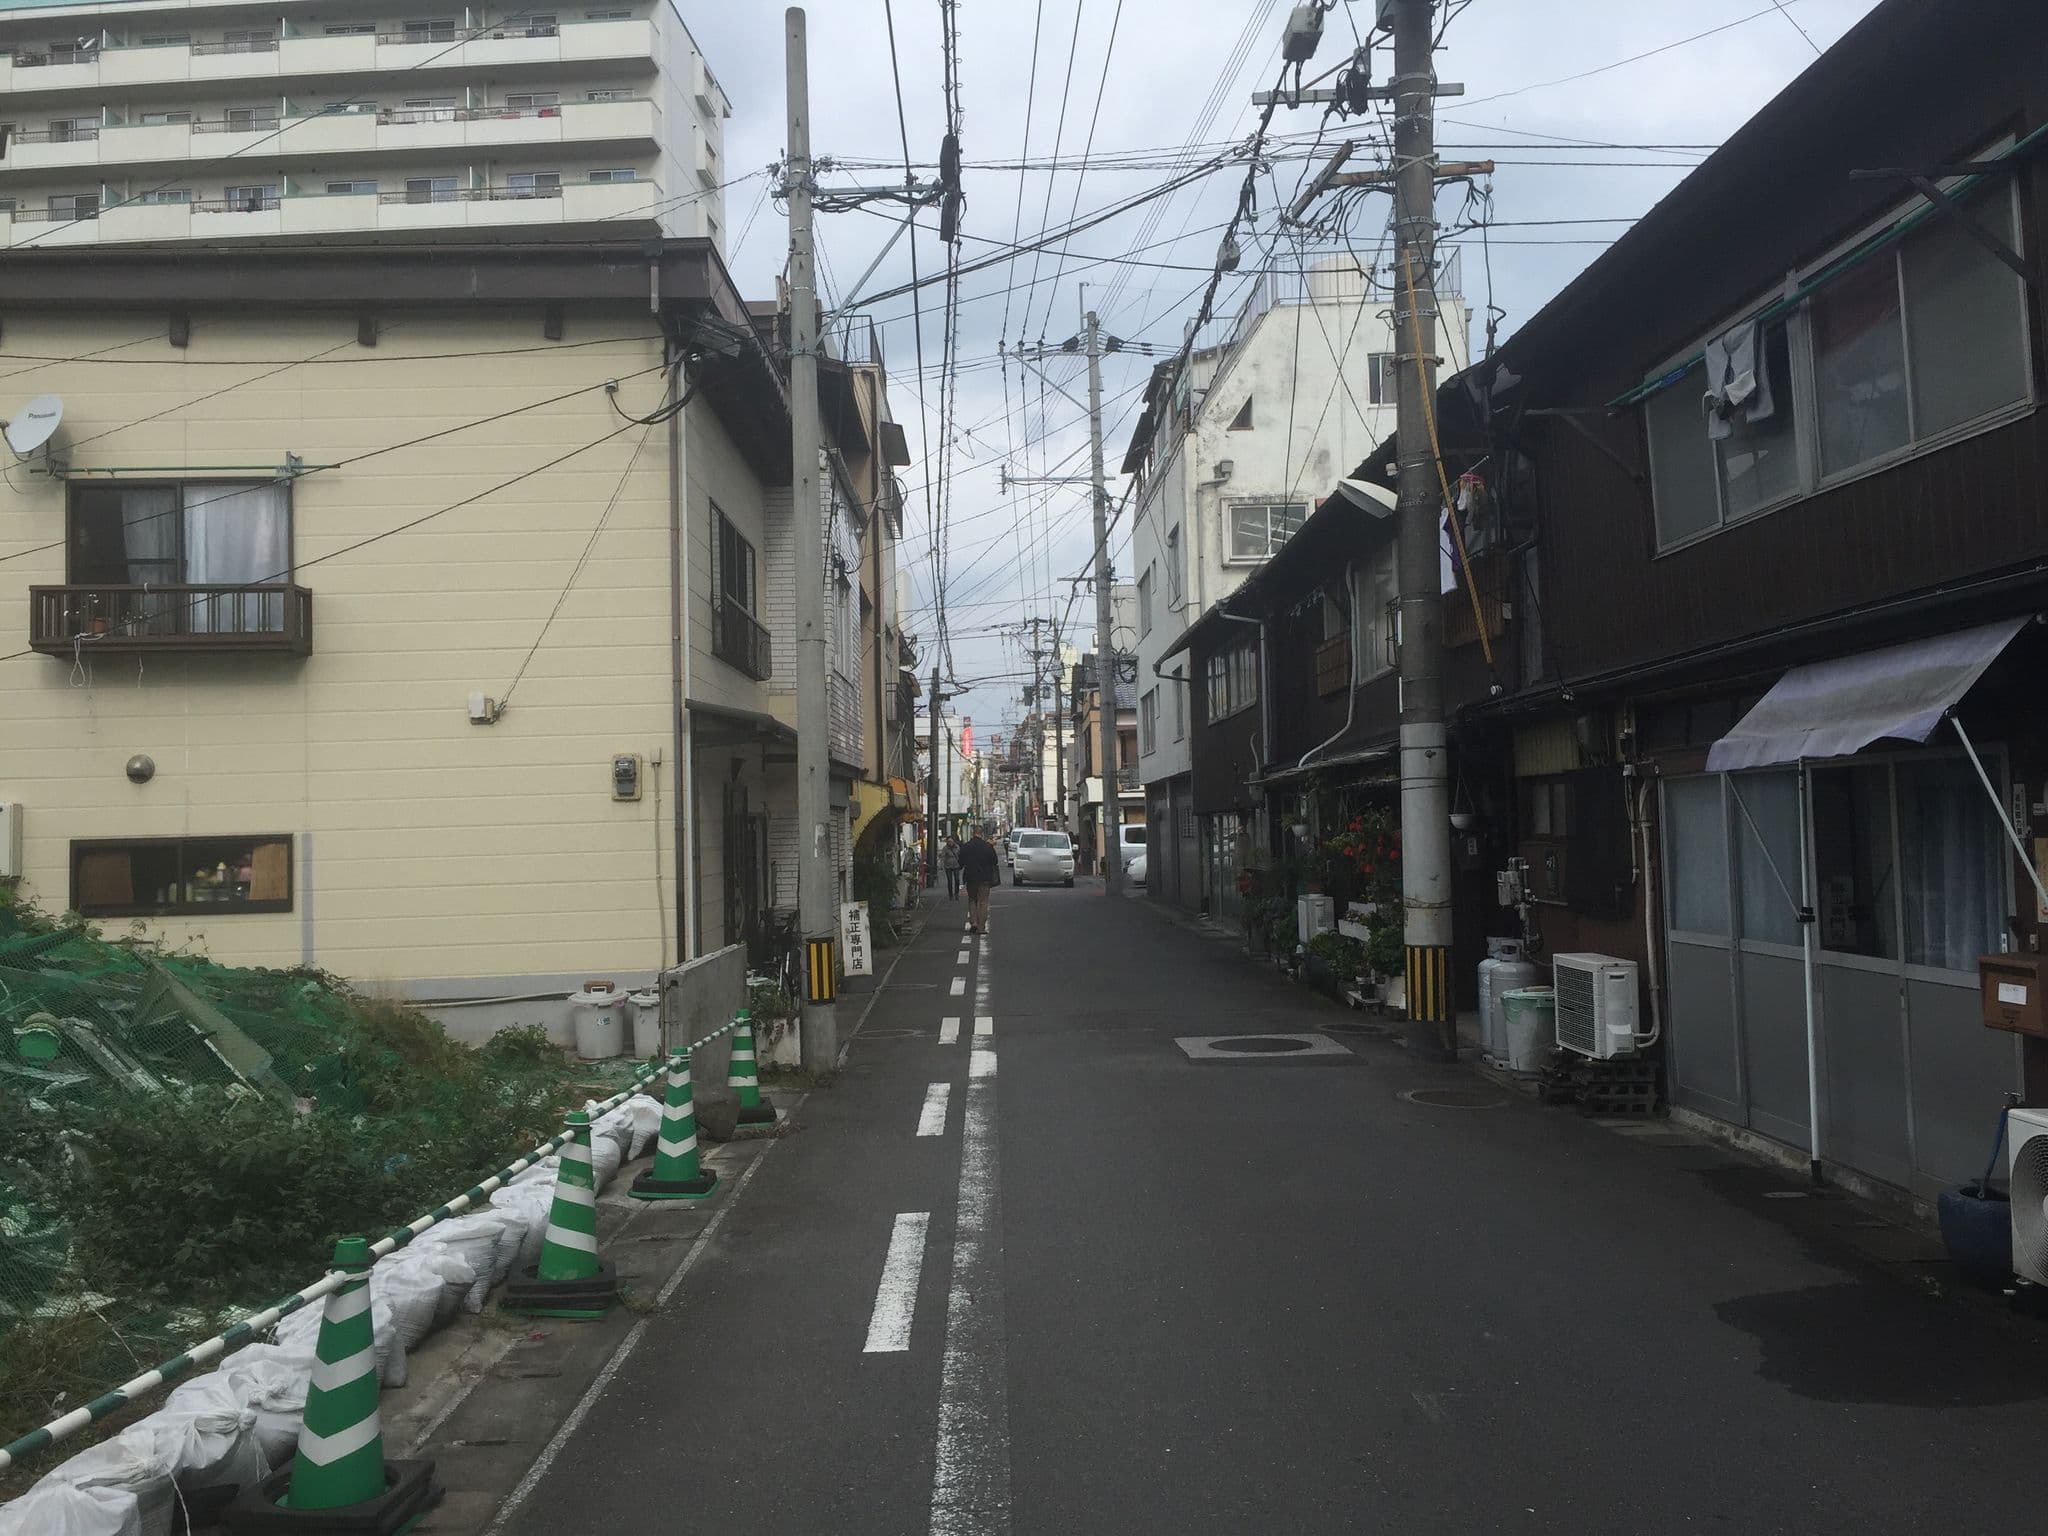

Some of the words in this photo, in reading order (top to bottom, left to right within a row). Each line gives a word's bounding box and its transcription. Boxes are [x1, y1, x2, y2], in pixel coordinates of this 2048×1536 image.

[848, 908, 863, 970] 補正専門店
